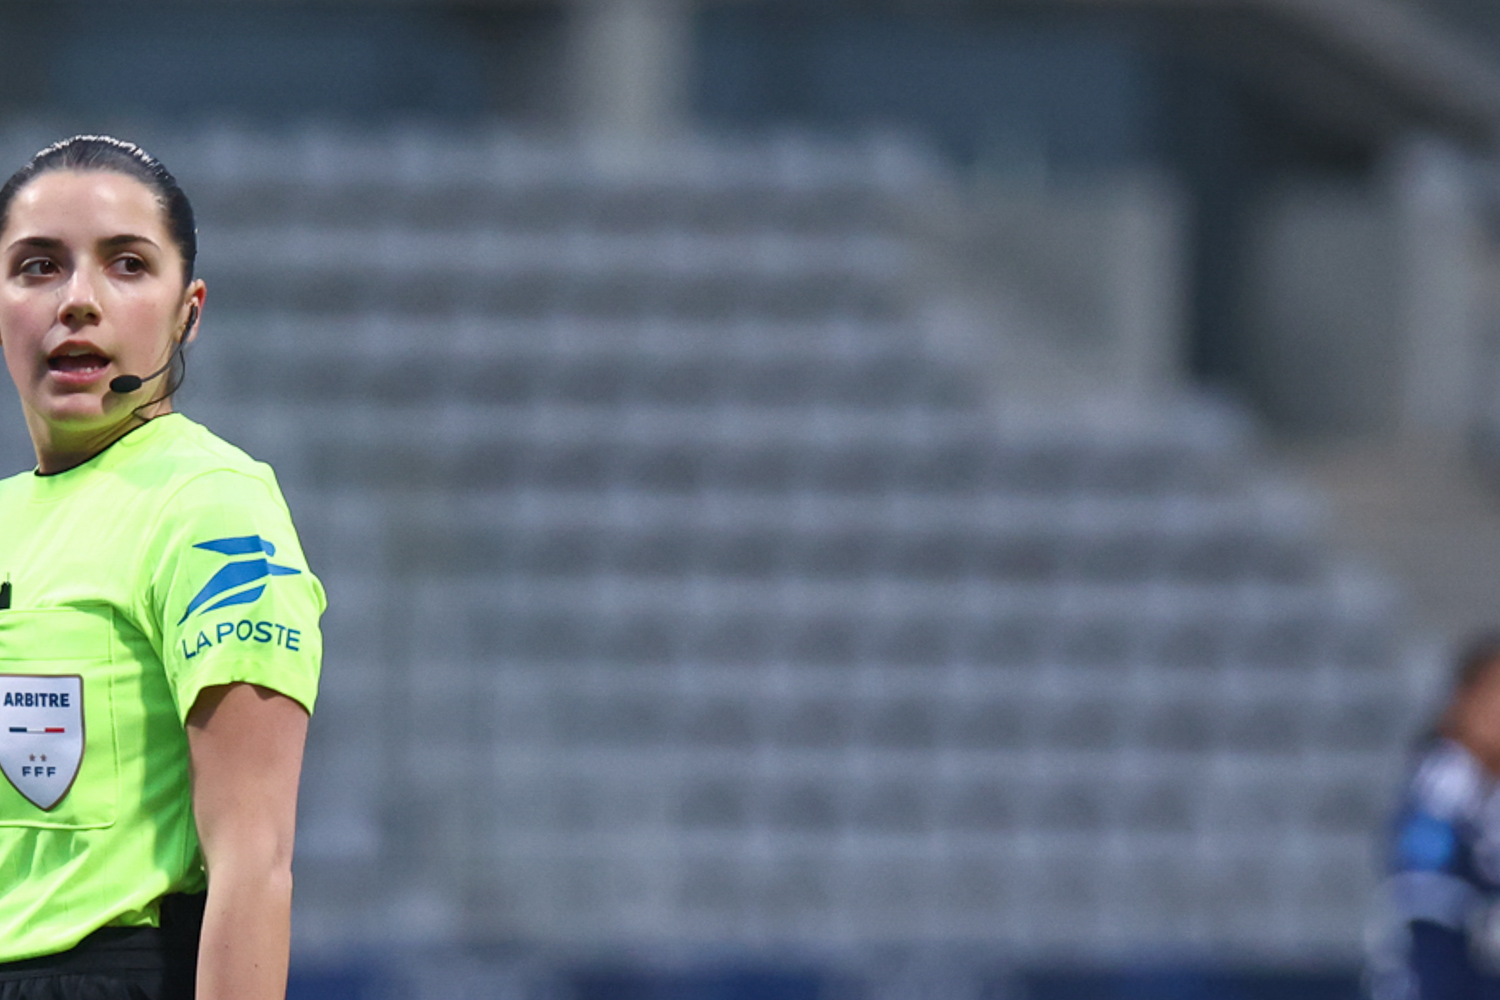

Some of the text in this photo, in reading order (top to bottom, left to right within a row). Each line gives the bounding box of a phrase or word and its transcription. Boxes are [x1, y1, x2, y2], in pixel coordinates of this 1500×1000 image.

[182, 619, 301, 660] LA POSTE
[3, 691, 70, 708] ARBITRE
[21, 765, 57, 778] FFF
